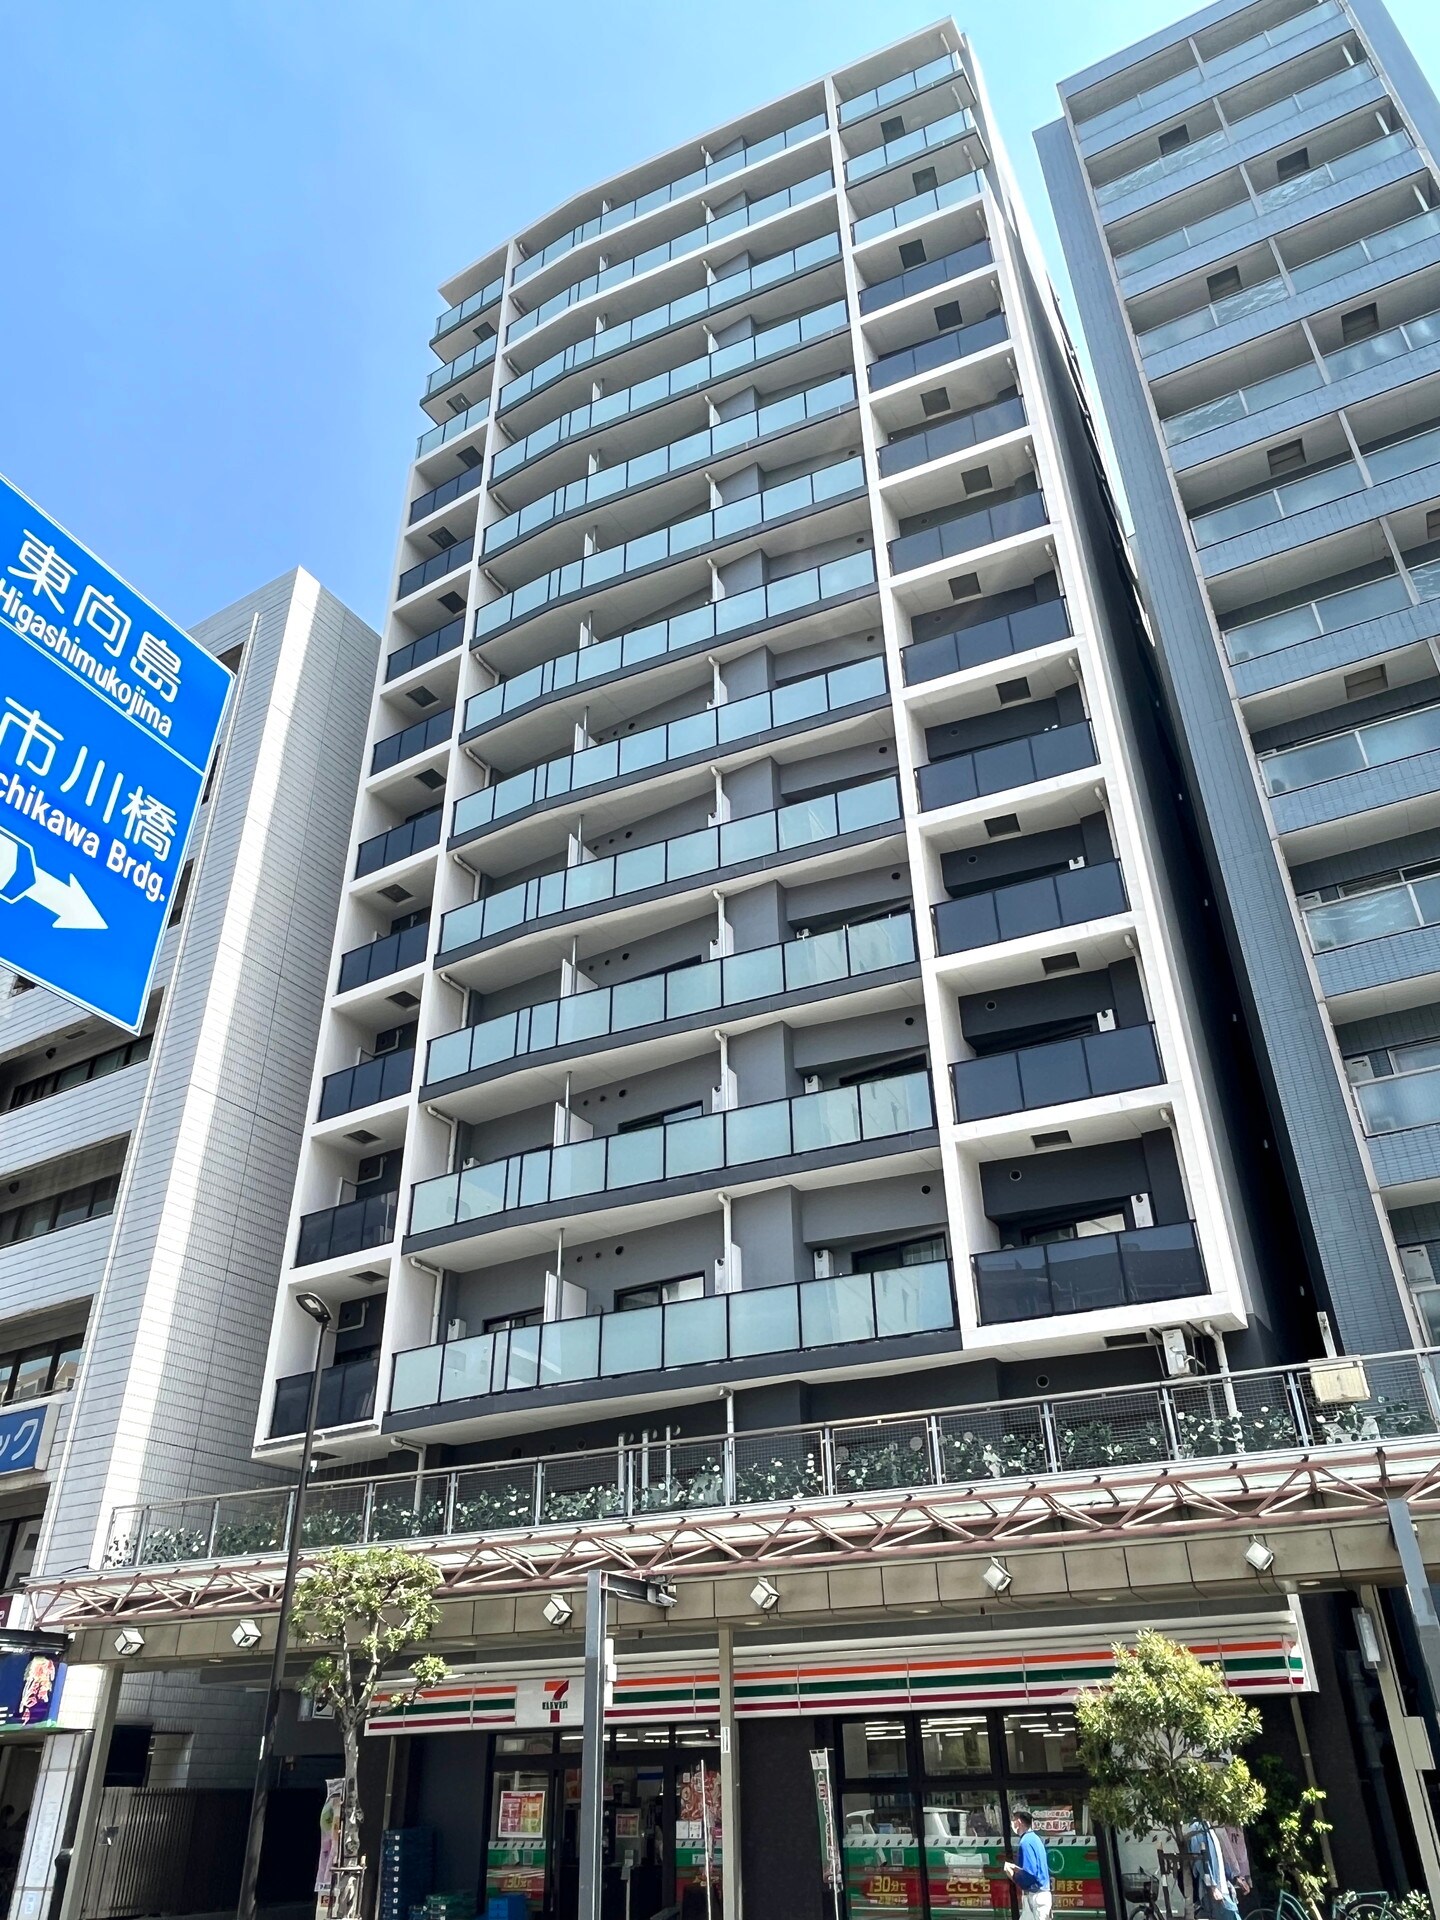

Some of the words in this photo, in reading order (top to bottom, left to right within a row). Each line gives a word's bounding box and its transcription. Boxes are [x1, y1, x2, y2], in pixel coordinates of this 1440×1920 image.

[0, 577, 173, 738] Higashimukojima
[7, 528, 182, 703] 東向島
[0, 696, 178, 862] 市川橋
[106, 838, 166, 902] Brdg.
[544, 1680, 569, 1723] 7
